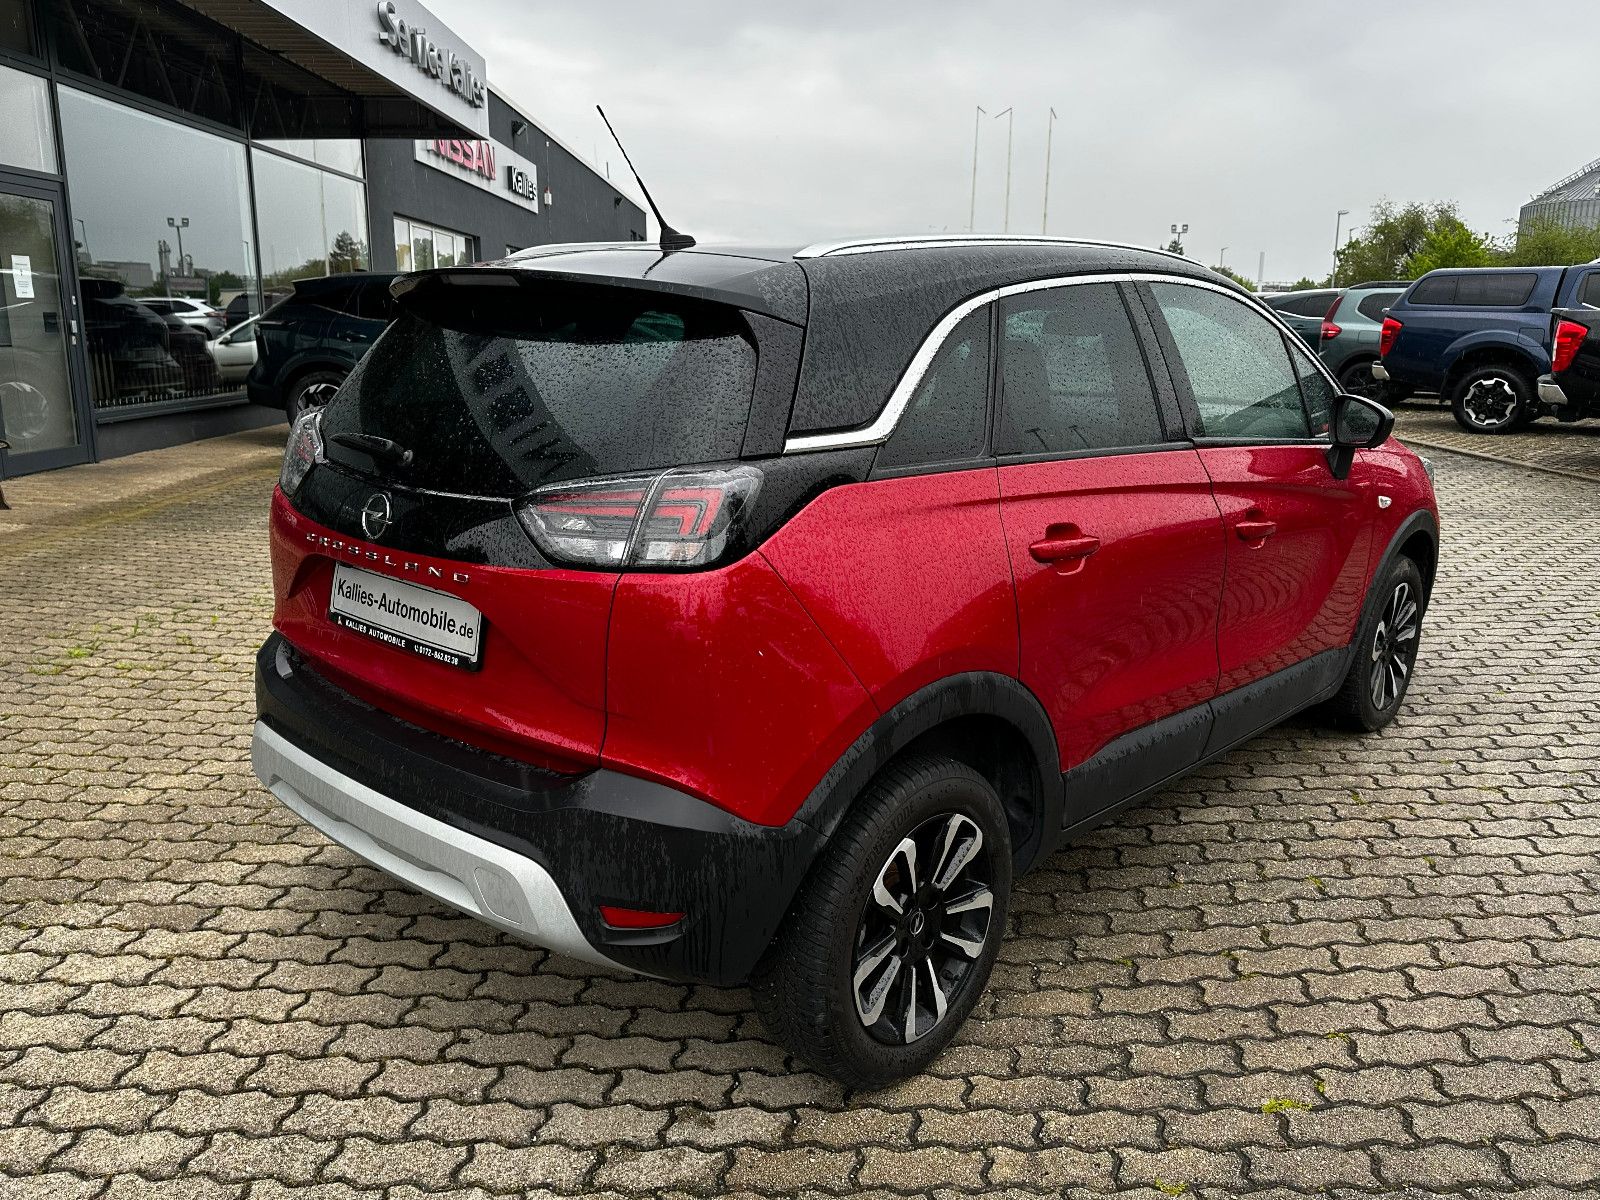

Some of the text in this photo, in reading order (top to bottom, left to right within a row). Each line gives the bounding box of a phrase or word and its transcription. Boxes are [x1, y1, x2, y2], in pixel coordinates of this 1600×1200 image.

[438, 48, 485, 108] Kallies
[429, 139, 496, 180] SSAN
[507, 165, 537, 200] Kallies
[306, 532, 470, 583] CROSSLAND
[336, 578, 474, 639] Kallies-Automobile.de
[345, 619, 367, 634] KALLIES
[368, 629, 406, 648] AUTOMOBILE
